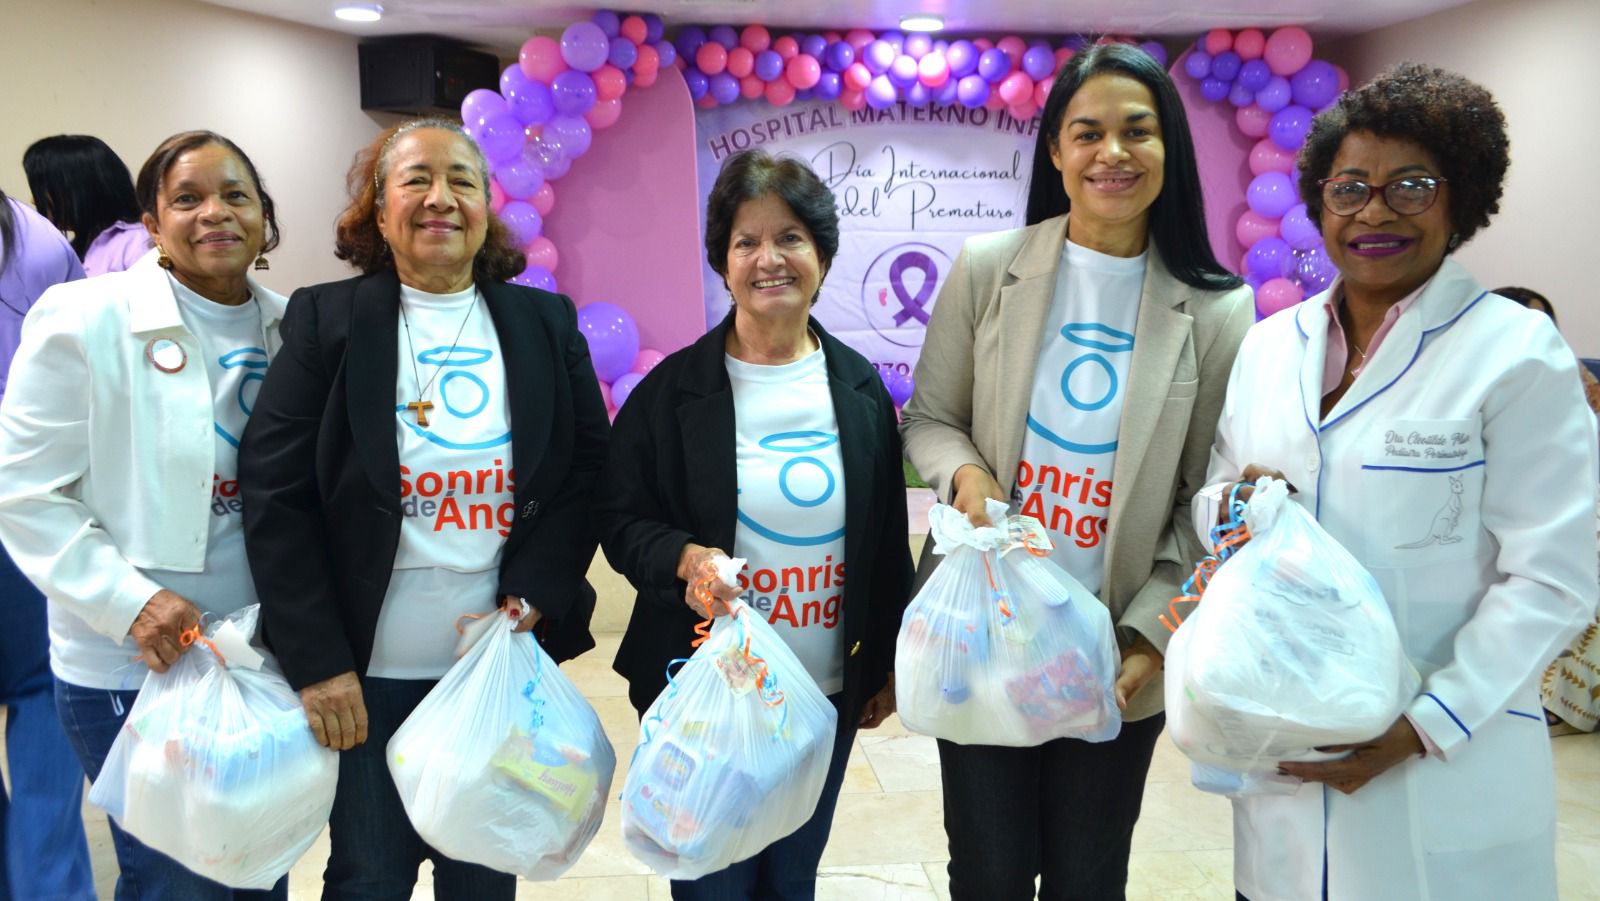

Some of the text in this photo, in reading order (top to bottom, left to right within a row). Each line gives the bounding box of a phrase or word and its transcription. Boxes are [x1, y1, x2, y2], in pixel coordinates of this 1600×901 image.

[709, 104, 843, 160] HOSPITAL
[852, 101, 989, 128] MATERNO
[811, 140, 1023, 194] Día Internacional
[838, 181, 1015, 231] del Prematuro
[211, 497, 244, 517] de
[402, 495, 436, 518] de
[768, 588, 846, 630] Áng
